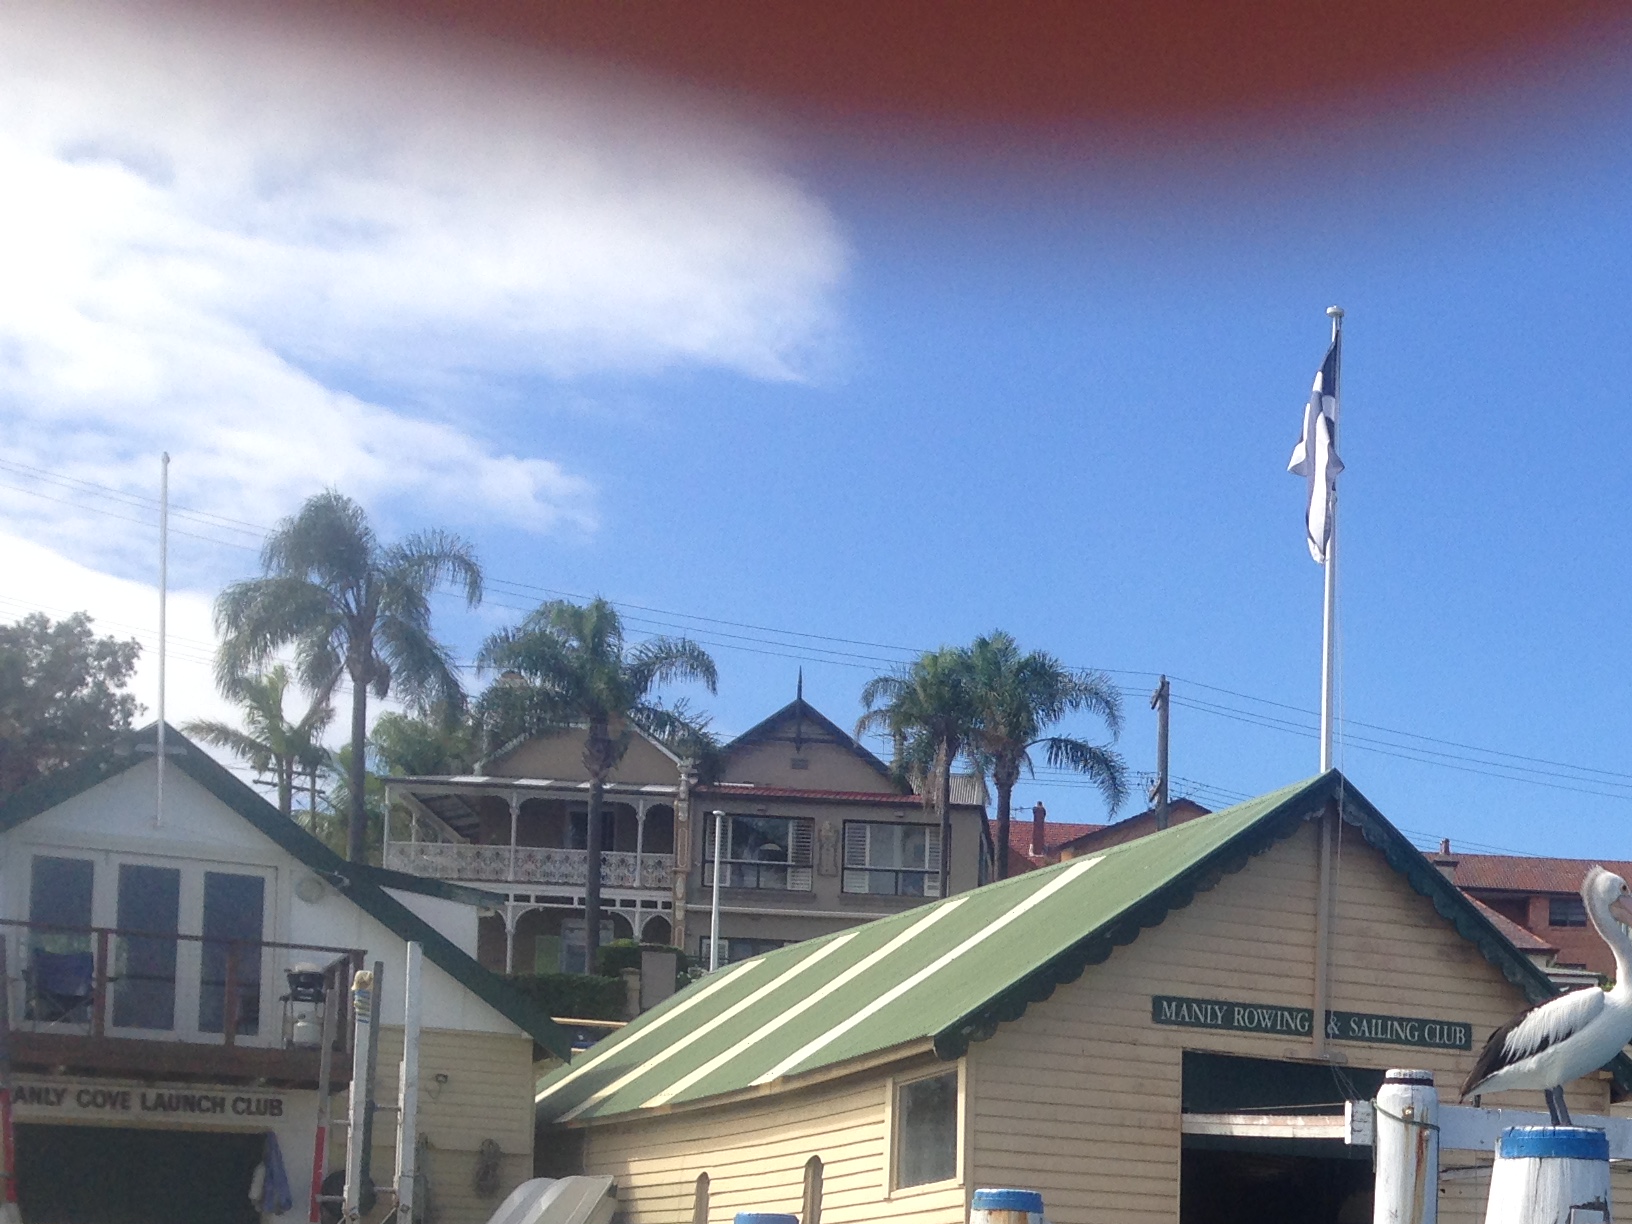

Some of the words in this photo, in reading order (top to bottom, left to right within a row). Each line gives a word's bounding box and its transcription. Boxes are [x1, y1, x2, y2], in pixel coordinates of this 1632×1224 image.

[1161, 1001, 1228, 1025] MANLY
[1233, 1006, 1310, 1032] ROWING
[1327, 1016, 1341, 1035] &
[1350, 1016, 1420, 1042] SAILING
[1424, 1023, 1466, 1046] CLUB
[12, 1085, 69, 1107] ANLY
[76, 1088, 132, 1111] COVE
[139, 1092, 226, 1114] LAUNCH
[231, 1096, 284, 1117] CLUB
